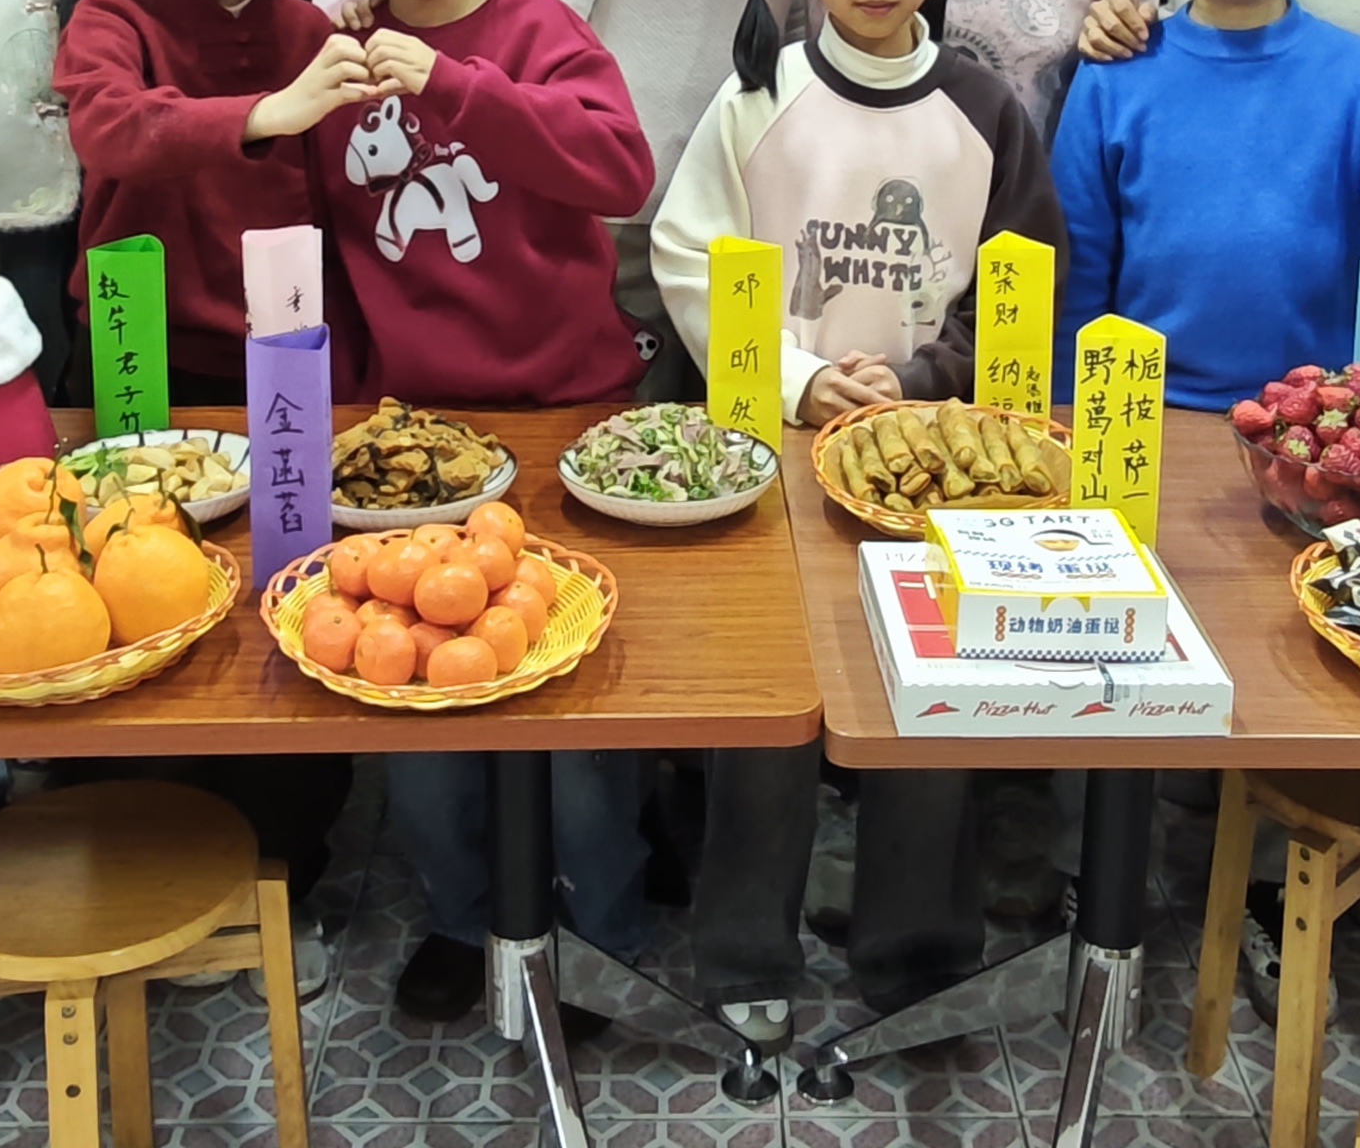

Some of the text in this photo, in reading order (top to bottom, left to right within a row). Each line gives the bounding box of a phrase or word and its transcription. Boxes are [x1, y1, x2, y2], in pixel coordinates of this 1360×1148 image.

[823, 256, 922, 292] WHITE
[1008, 617, 1120, 635] 动物奶油蛋挞
[972, 700, 1058, 718] Pizza Hut
[1127, 700, 1215, 718] Pizza Hut
